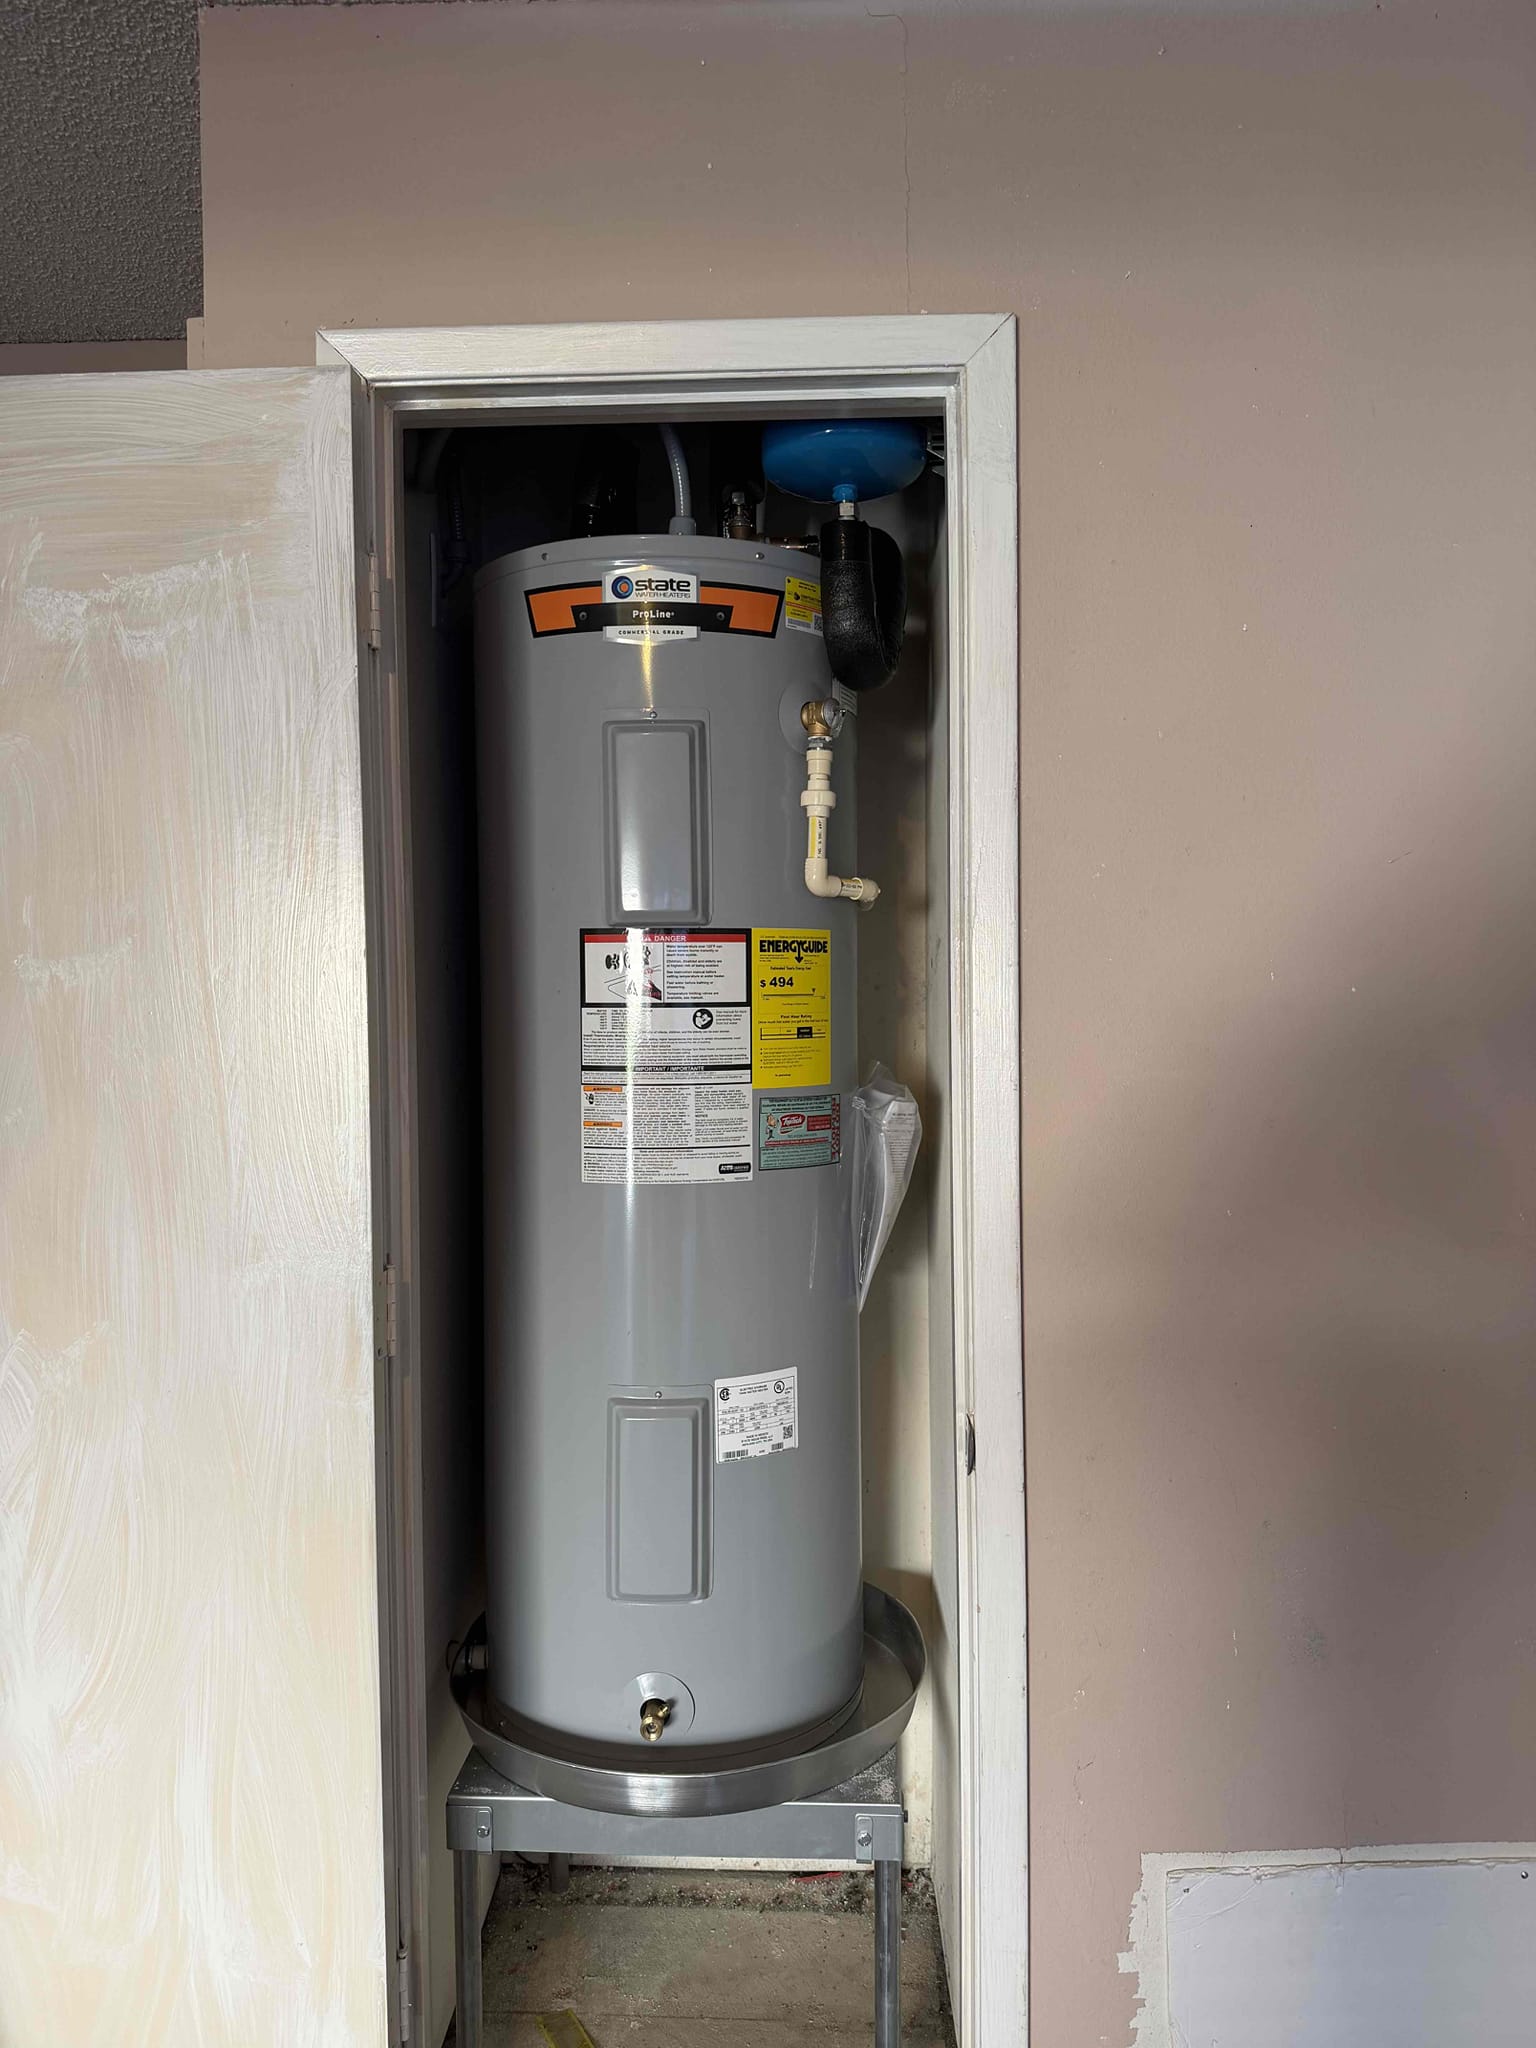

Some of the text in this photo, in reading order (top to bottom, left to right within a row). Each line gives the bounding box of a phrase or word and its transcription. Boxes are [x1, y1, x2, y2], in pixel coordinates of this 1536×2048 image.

[635, 578, 690, 592] state
[760, 940, 828, 954] ENERGYGUIDE
[760, 977, 794, 988] $ 494
